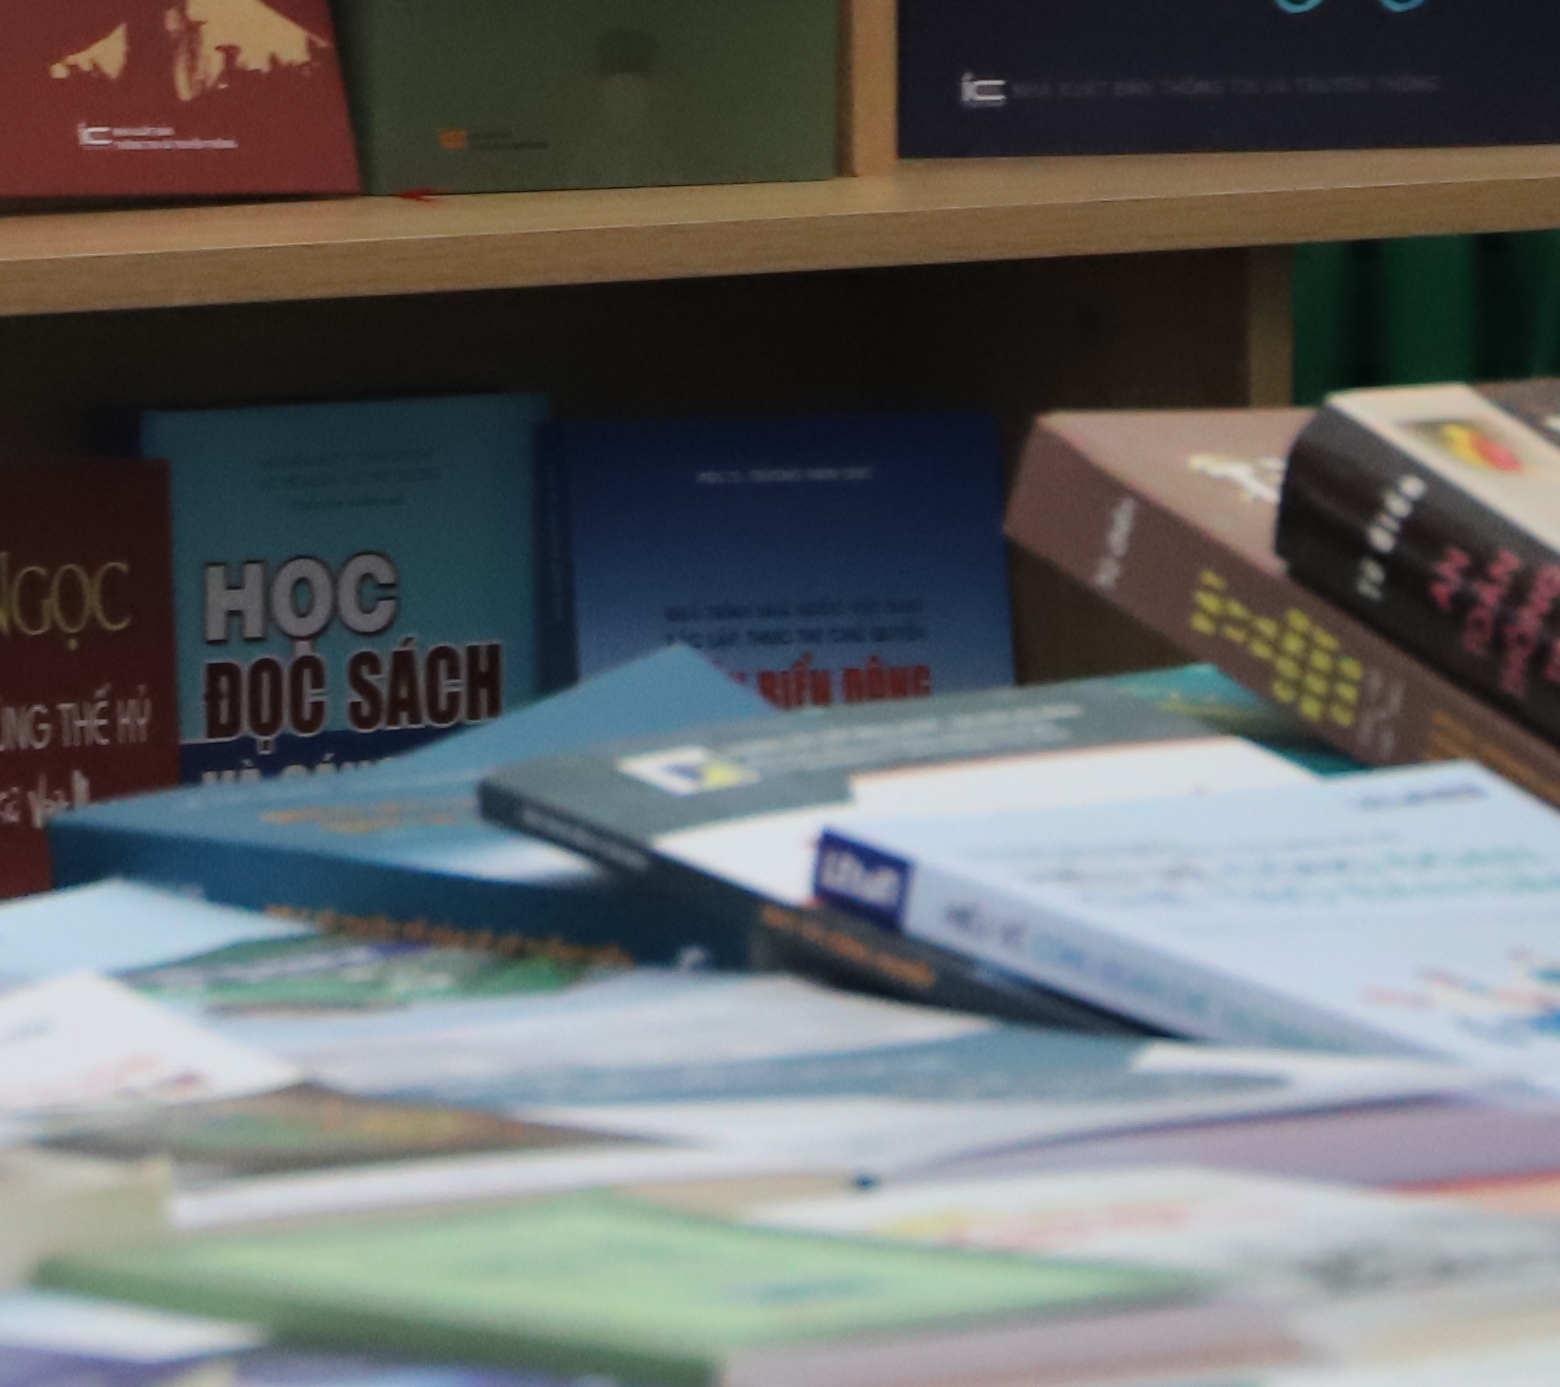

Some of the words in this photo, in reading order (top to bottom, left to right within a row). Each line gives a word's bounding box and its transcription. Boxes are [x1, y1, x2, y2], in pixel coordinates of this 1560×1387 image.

[202, 549, 401, 657] HỌC
[203, 641, 326, 757] ĐỌC
[348, 635, 503, 734] SÁCH
